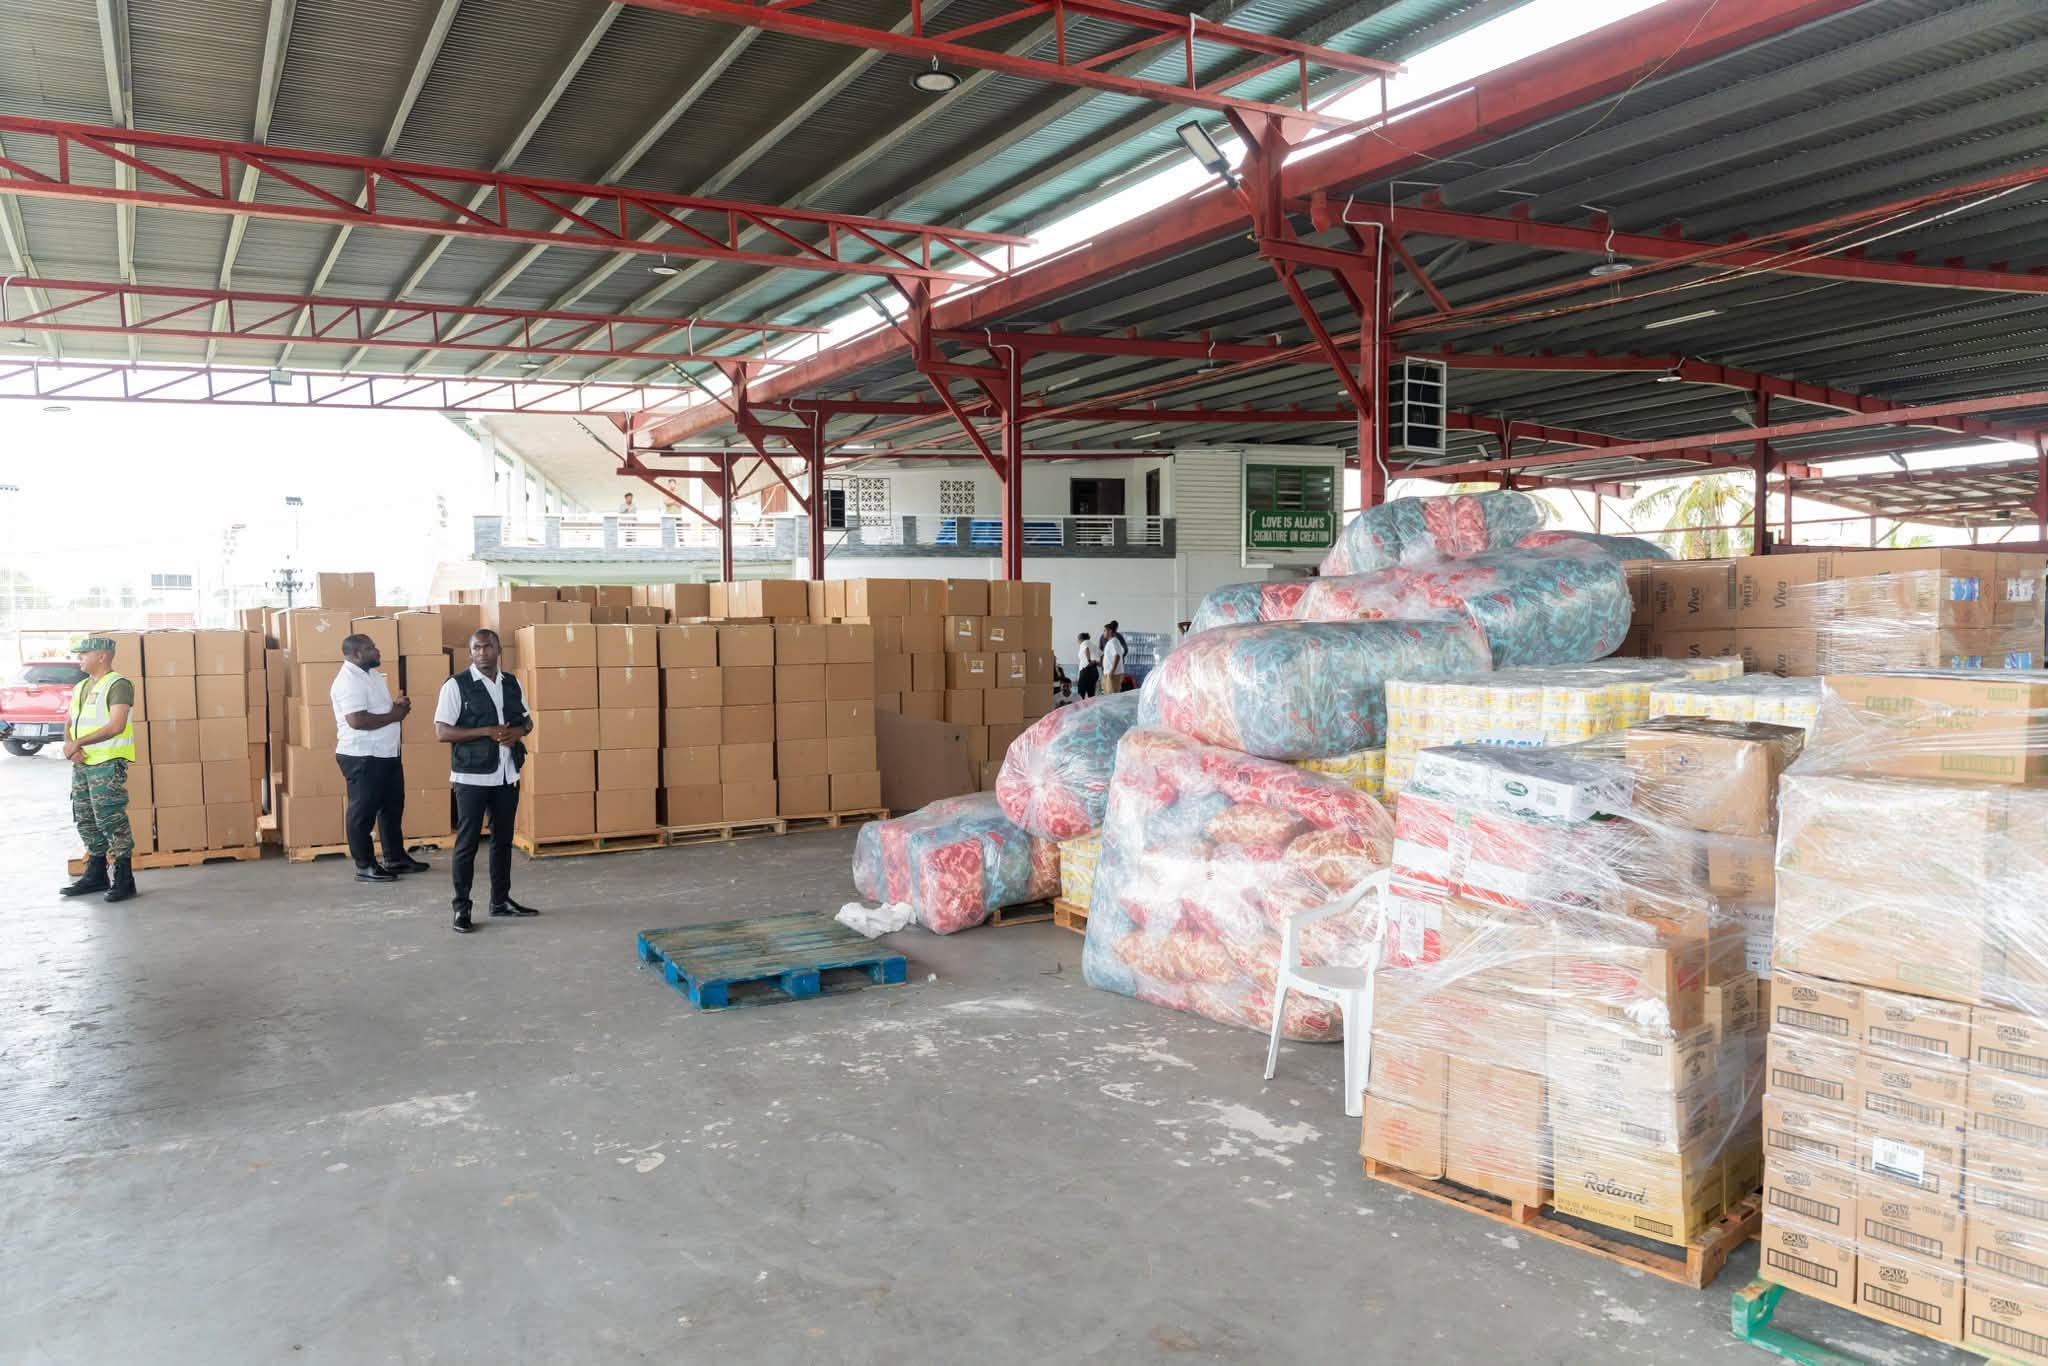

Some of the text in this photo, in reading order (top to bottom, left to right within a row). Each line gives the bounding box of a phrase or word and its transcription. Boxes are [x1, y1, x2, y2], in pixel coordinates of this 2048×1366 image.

[1262, 516, 1325, 529] LOVE IS ALLAH'S
[1253, 530, 1288, 542] SIGNATURE
[1300, 530, 1329, 542] CREATION
[1583, 1171, 1648, 1204] Roland
